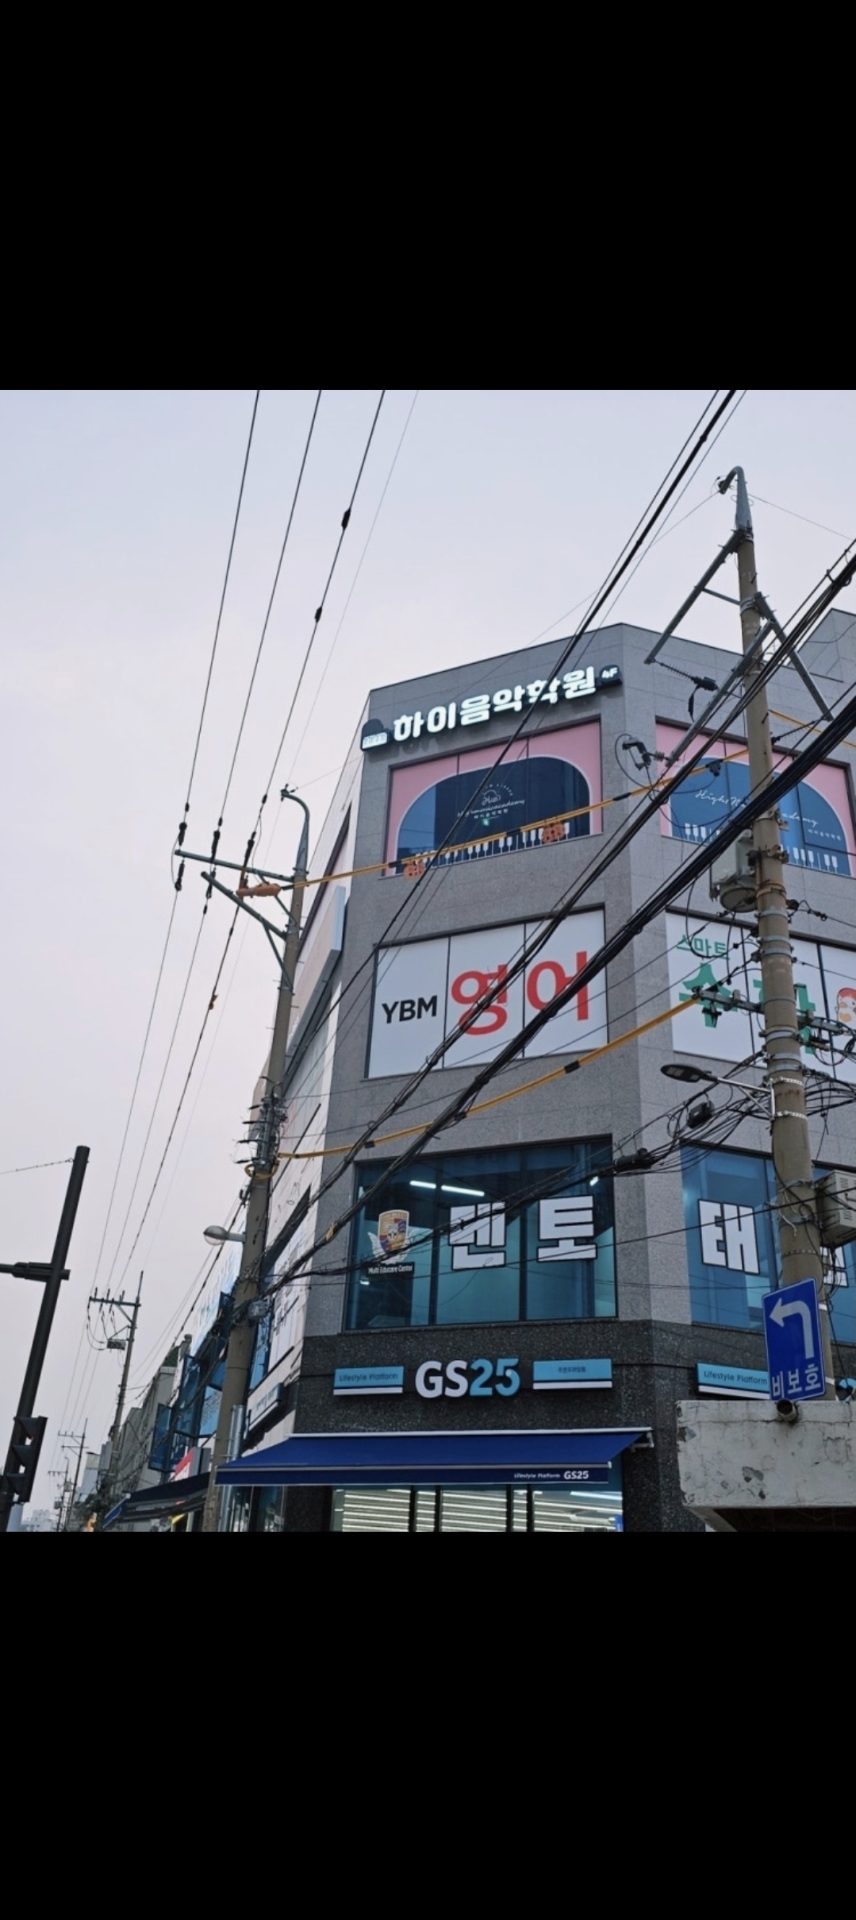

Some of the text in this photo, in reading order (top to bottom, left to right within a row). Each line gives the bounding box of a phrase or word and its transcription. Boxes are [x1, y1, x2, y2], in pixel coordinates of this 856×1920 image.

[393, 666, 619, 742] 하이음악학원 4F
[676, 934, 731, 961] 스마트
[381, 950, 590, 1036] YBM 영어
[449, 1195, 598, 1270] 멘토
[398, 1264, 413, 1273] Center
[339, 1372, 398, 1383] Lifestyle Platform
[415, 1357, 521, 1399] GS25
[703, 1370, 768, 1385] Lifestyle Platform
[771, 1363, 822, 1399] 비보호
[513, 1472, 536, 1480] Lifestyle
[563, 1470, 590, 1480] GS25
